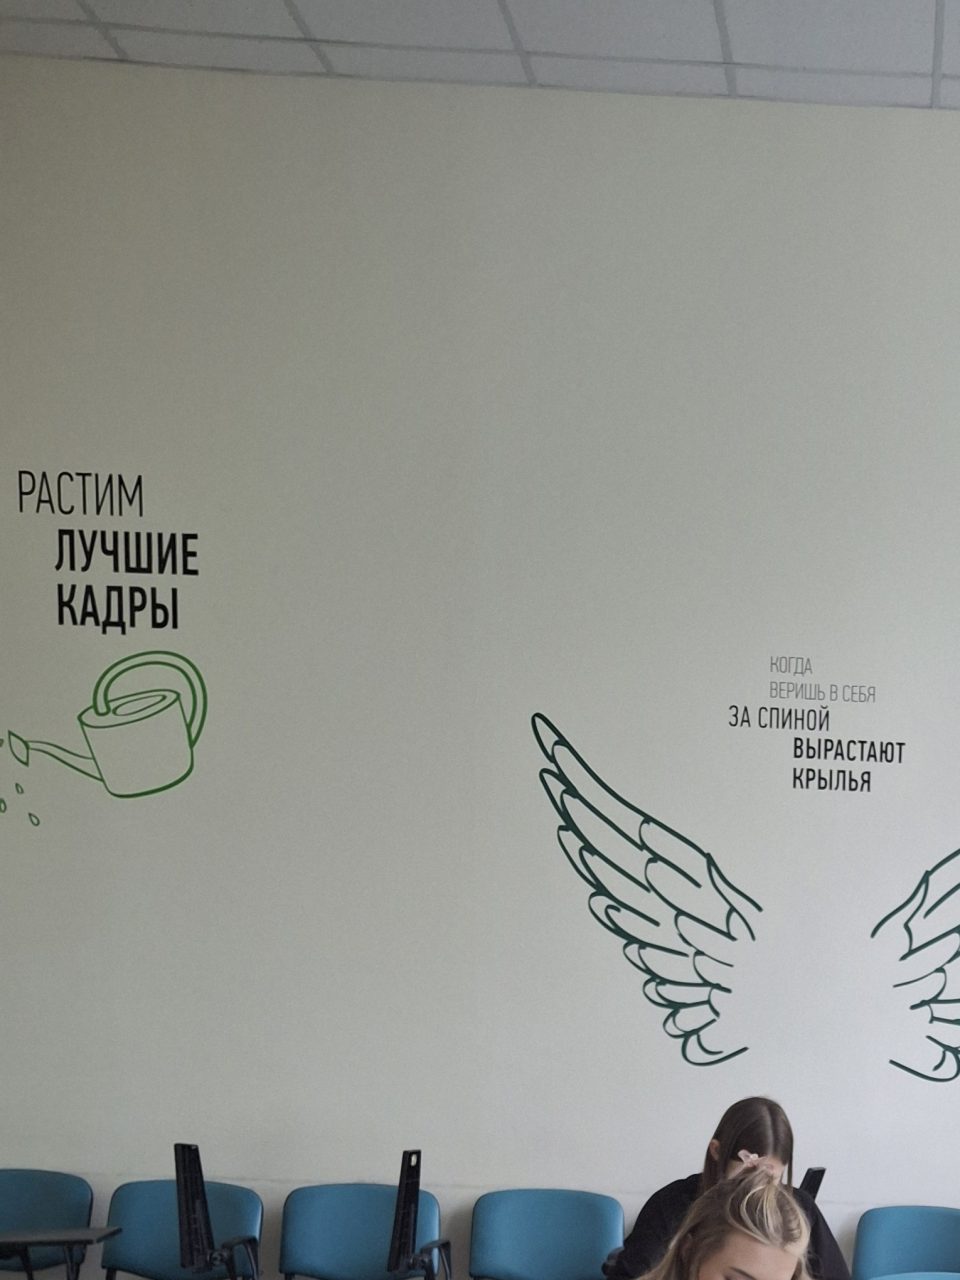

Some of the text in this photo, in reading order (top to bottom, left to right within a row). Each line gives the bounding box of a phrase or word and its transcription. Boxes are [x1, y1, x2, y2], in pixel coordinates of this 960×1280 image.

[18, 470, 143, 518] РАСТИМ
[54, 528, 199, 576] ЛУЧШИЕ
[57, 583, 179, 636] КАДРЫ
[769, 655, 813, 677] КОГДА
[769, 681, 876, 703] ВЕРИШЬ В СЕБЯ
[728, 704, 830, 732] ЗА СПИНОЙ
[793, 736, 906, 764] ВЫРАСТАЮТ
[792, 767, 871, 793] КРЫЛЬЯ
